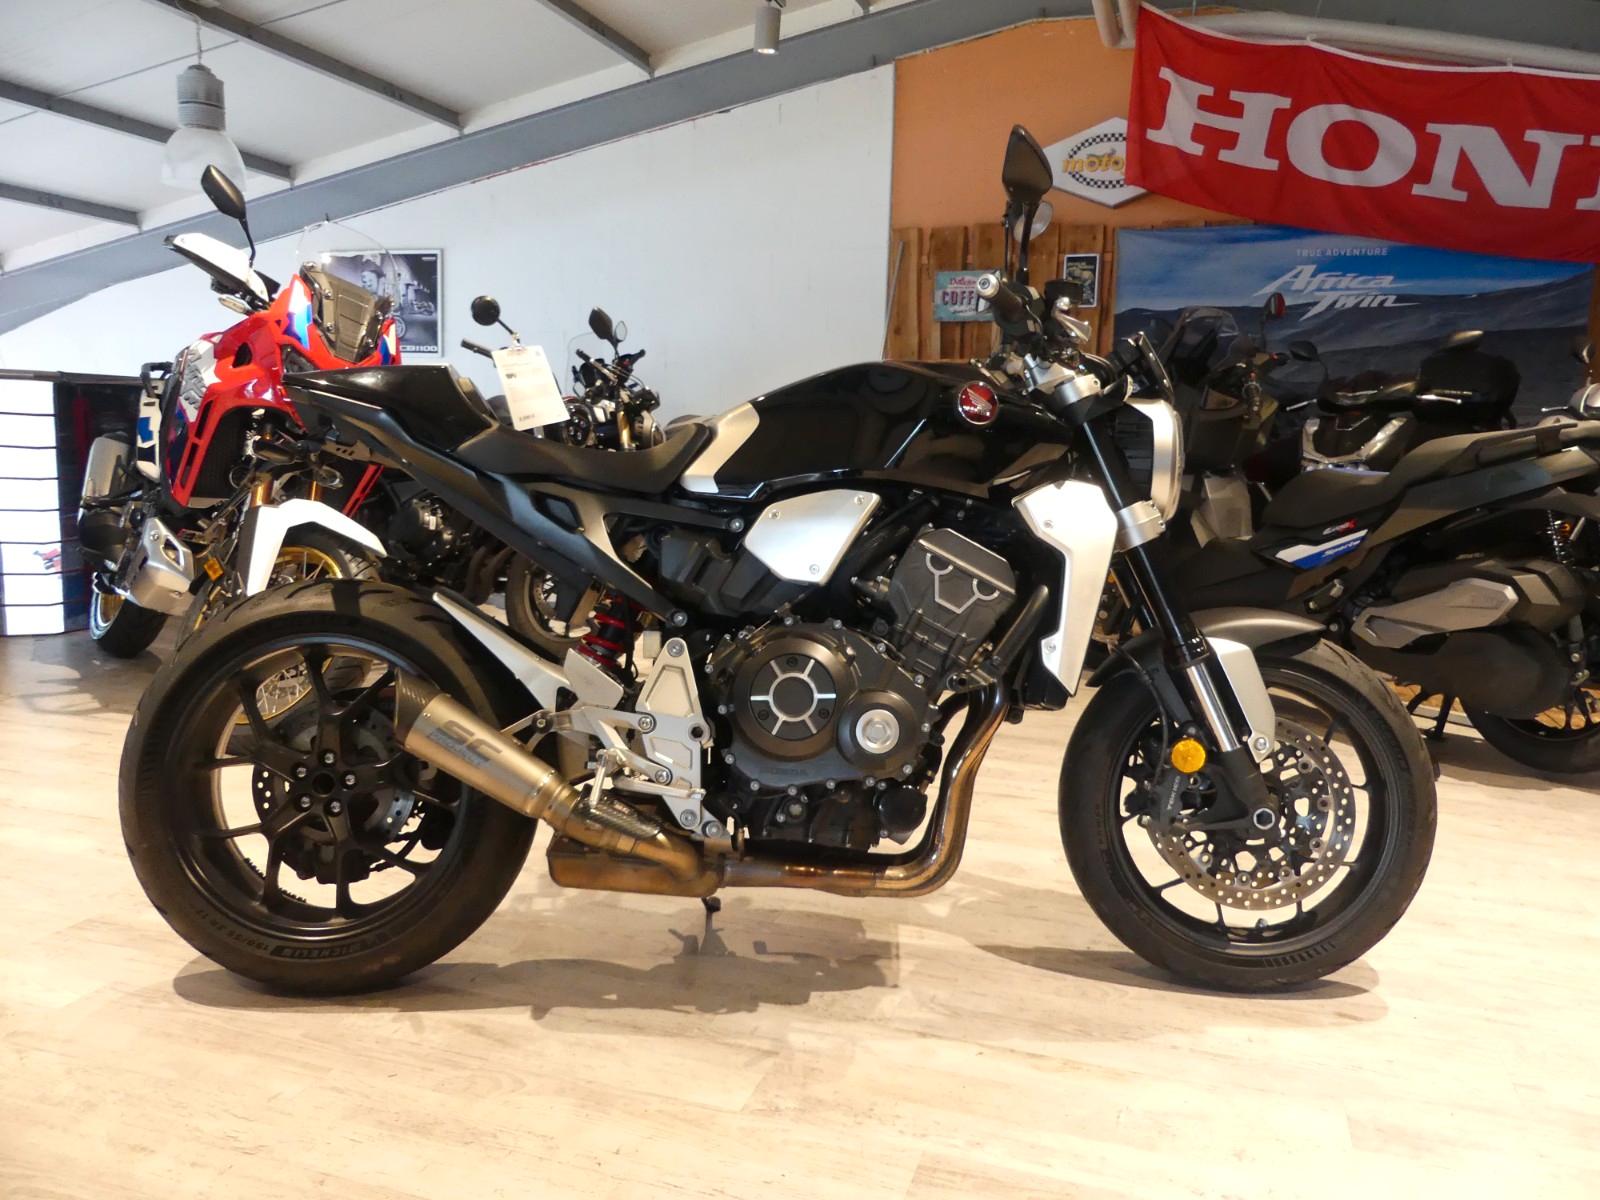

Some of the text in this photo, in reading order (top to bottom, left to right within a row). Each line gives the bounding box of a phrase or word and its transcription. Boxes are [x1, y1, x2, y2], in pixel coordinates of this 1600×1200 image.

[1146, 66, 1600, 211] HON
[1297, 247, 1388, 257] TRUE ADVENTURE
[1253, 264, 1413, 296] Africa
[1299, 288, 1420, 322] Twin
